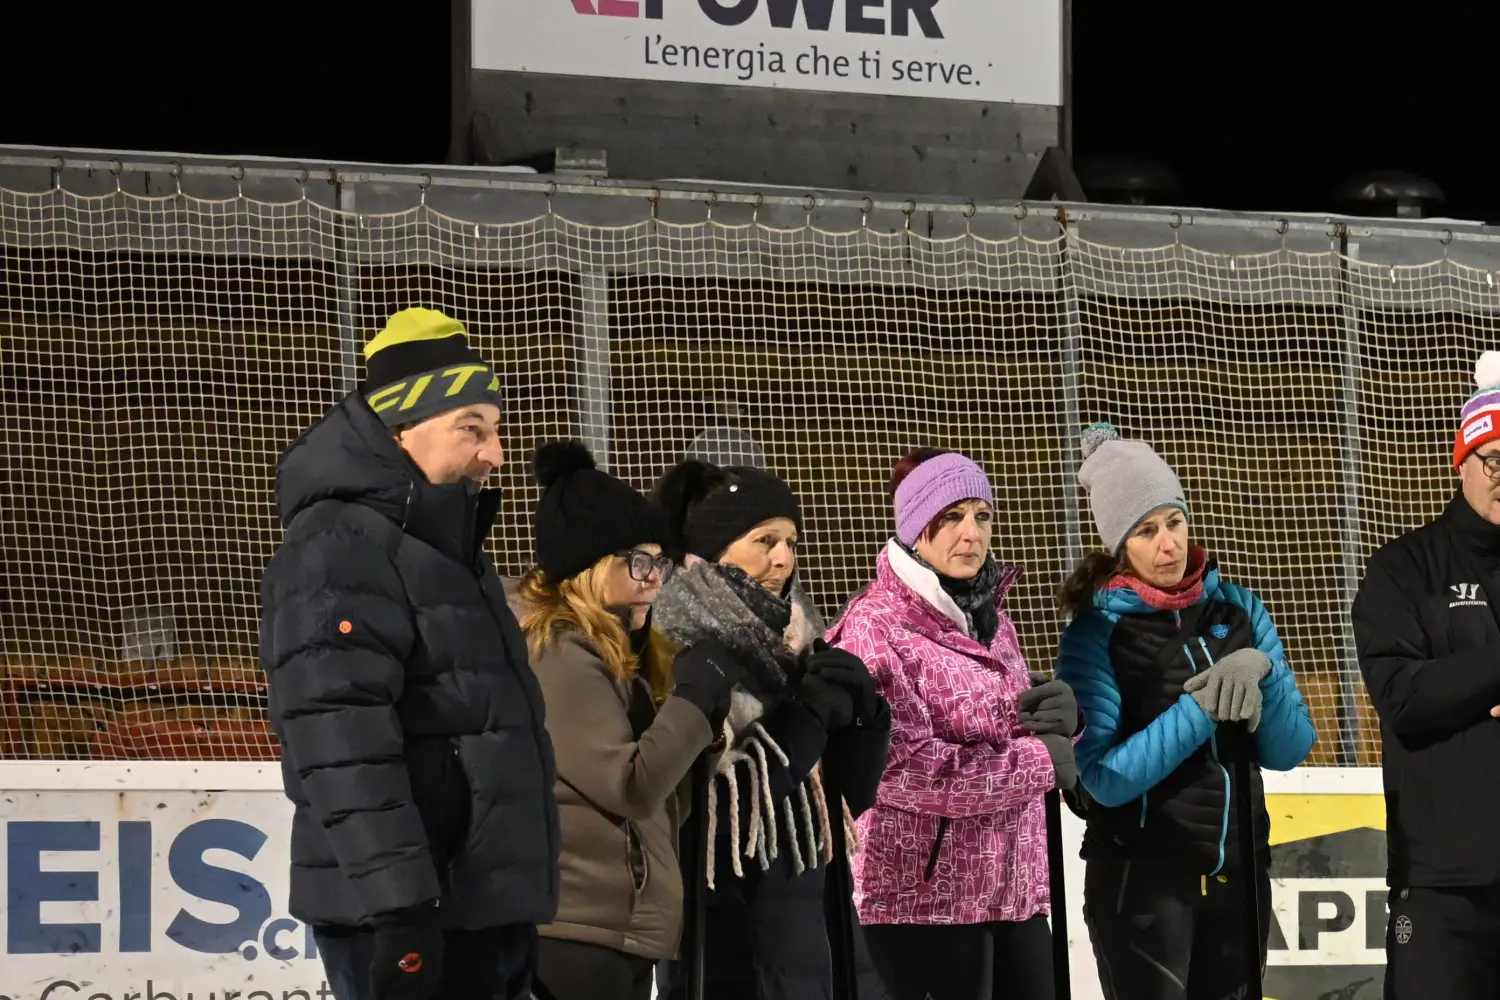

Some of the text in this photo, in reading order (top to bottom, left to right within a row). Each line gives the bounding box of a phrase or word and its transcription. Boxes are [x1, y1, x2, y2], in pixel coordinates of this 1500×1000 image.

[795, 46, 850, 77] che
[858, 49, 881, 79] ti
[891, 57, 982, 86] serve.
